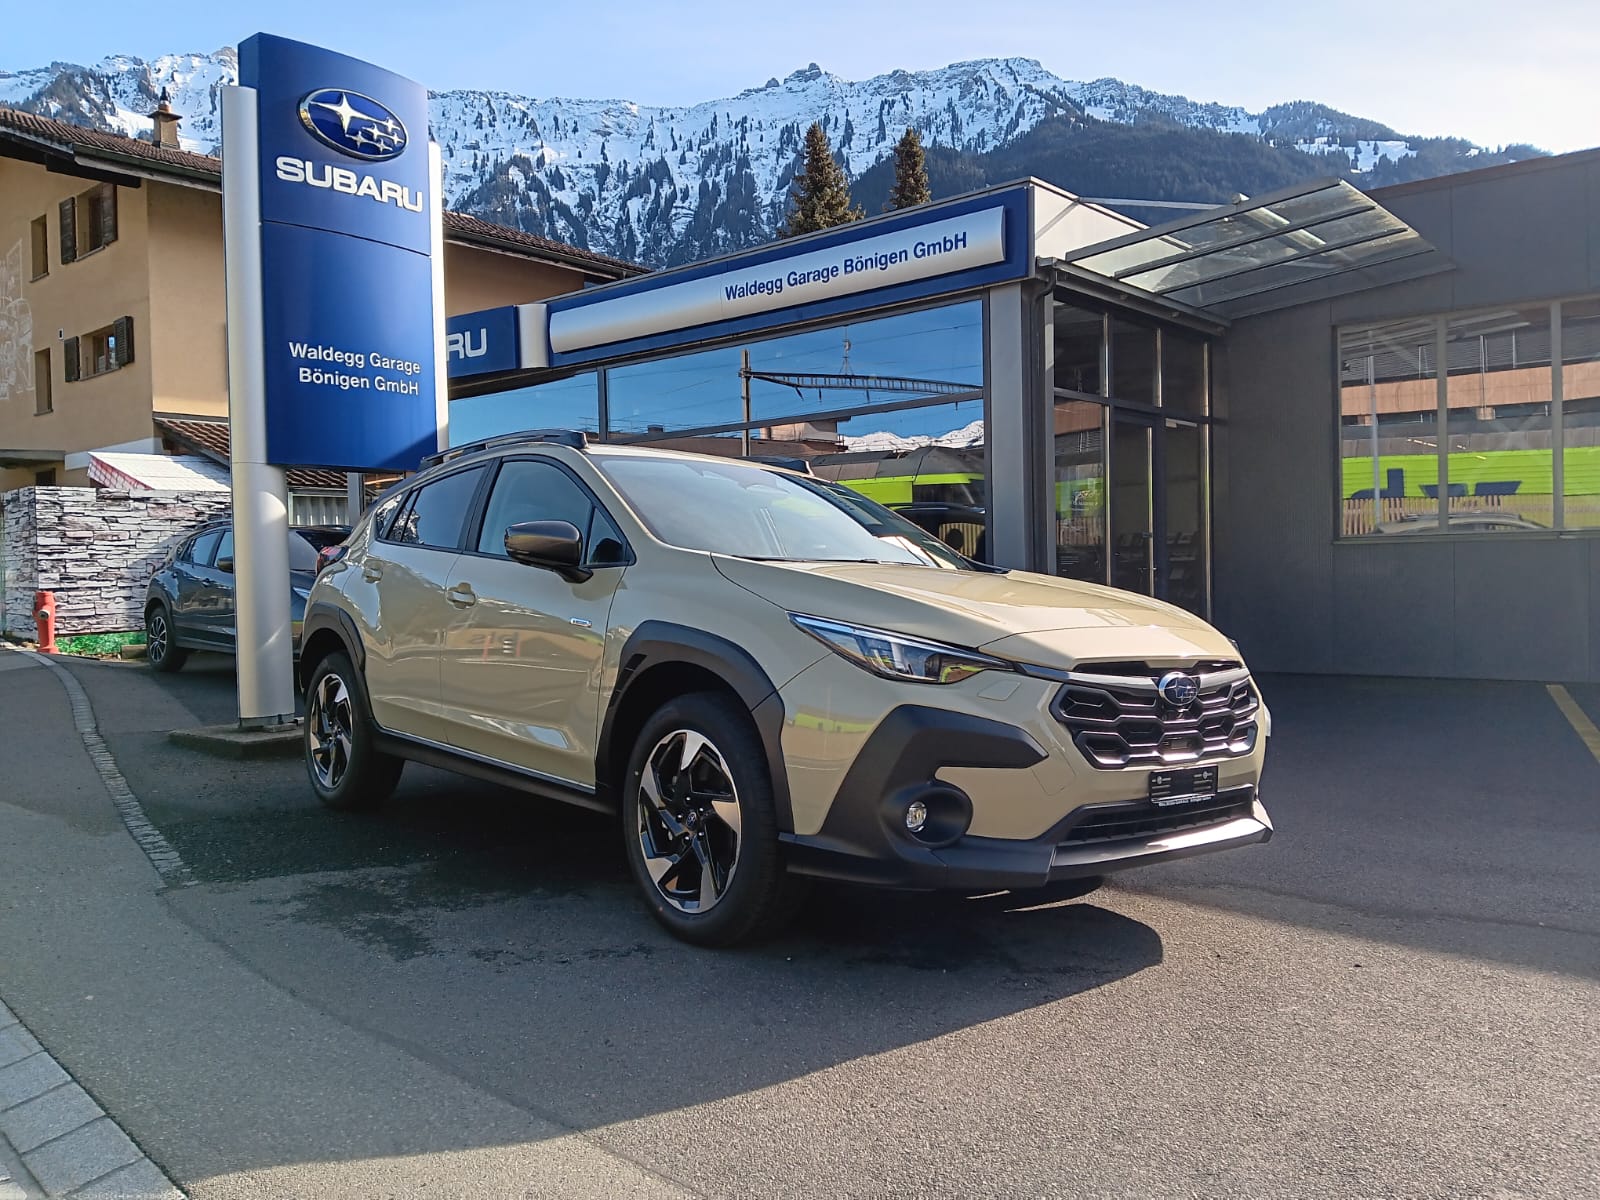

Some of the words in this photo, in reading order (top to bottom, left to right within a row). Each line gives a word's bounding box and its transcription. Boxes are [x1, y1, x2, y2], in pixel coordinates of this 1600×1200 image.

[275, 155, 423, 213] SUBARU
[725, 277, 783, 301] Waldegg
[787, 262, 839, 285] Garage
[843, 249, 908, 275] Bönigen
[913, 231, 967, 259] GmbH
[288, 341, 365, 369] Waldegg
[369, 352, 421, 376] Garage
[299, 366, 370, 390] Bönigen
[374, 375, 419, 396] GmbH
